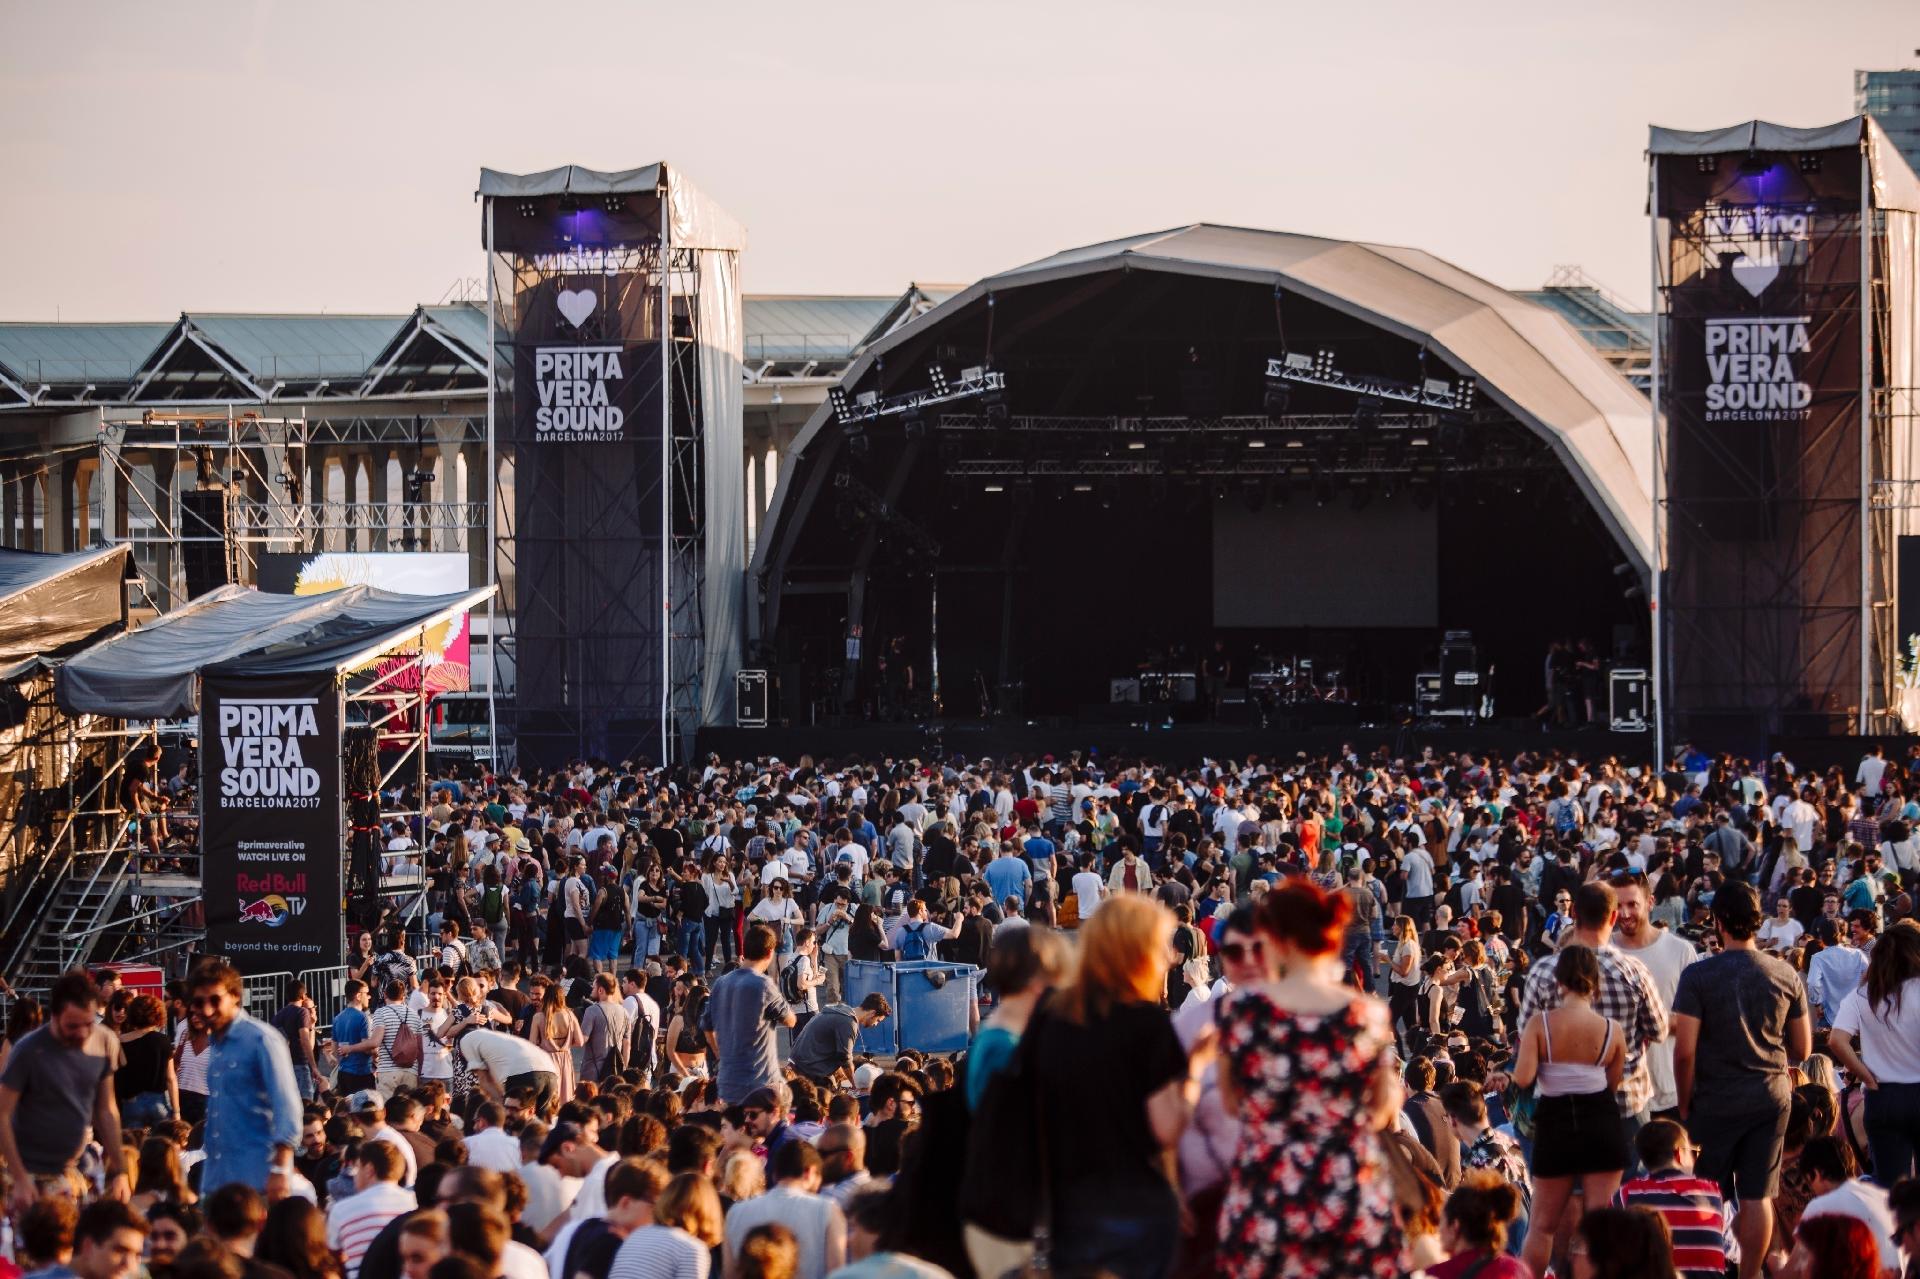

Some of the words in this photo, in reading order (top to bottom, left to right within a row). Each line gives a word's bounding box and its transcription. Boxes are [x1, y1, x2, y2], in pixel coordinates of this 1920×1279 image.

[1705, 324, 1812, 354] PRIMA
[535, 352, 624, 380] PRIMA
[1706, 354, 1795, 383] VERA
[536, 380, 610, 407] VERA
[1705, 383, 1813, 410] SOUND
[536, 406, 624, 432] SOUND
[220, 705, 320, 737] PRIMA
[221, 736, 304, 768] VERA
[220, 767, 321, 797] SOUND
[220, 797, 321, 809] BARCELONA2017
[237, 840, 305, 851] #primaveralive
[238, 853, 270, 862] WATCH
[271, 853, 290, 861] LIVE
[292, 853, 306, 862] ON
[236, 872, 271, 893] Red
[273, 872, 307, 893] Bull
[286, 896, 307, 916] TV
[224, 941, 261, 952] beyond
[263, 942, 279, 951] the
[282, 942, 322, 954] ordinary
